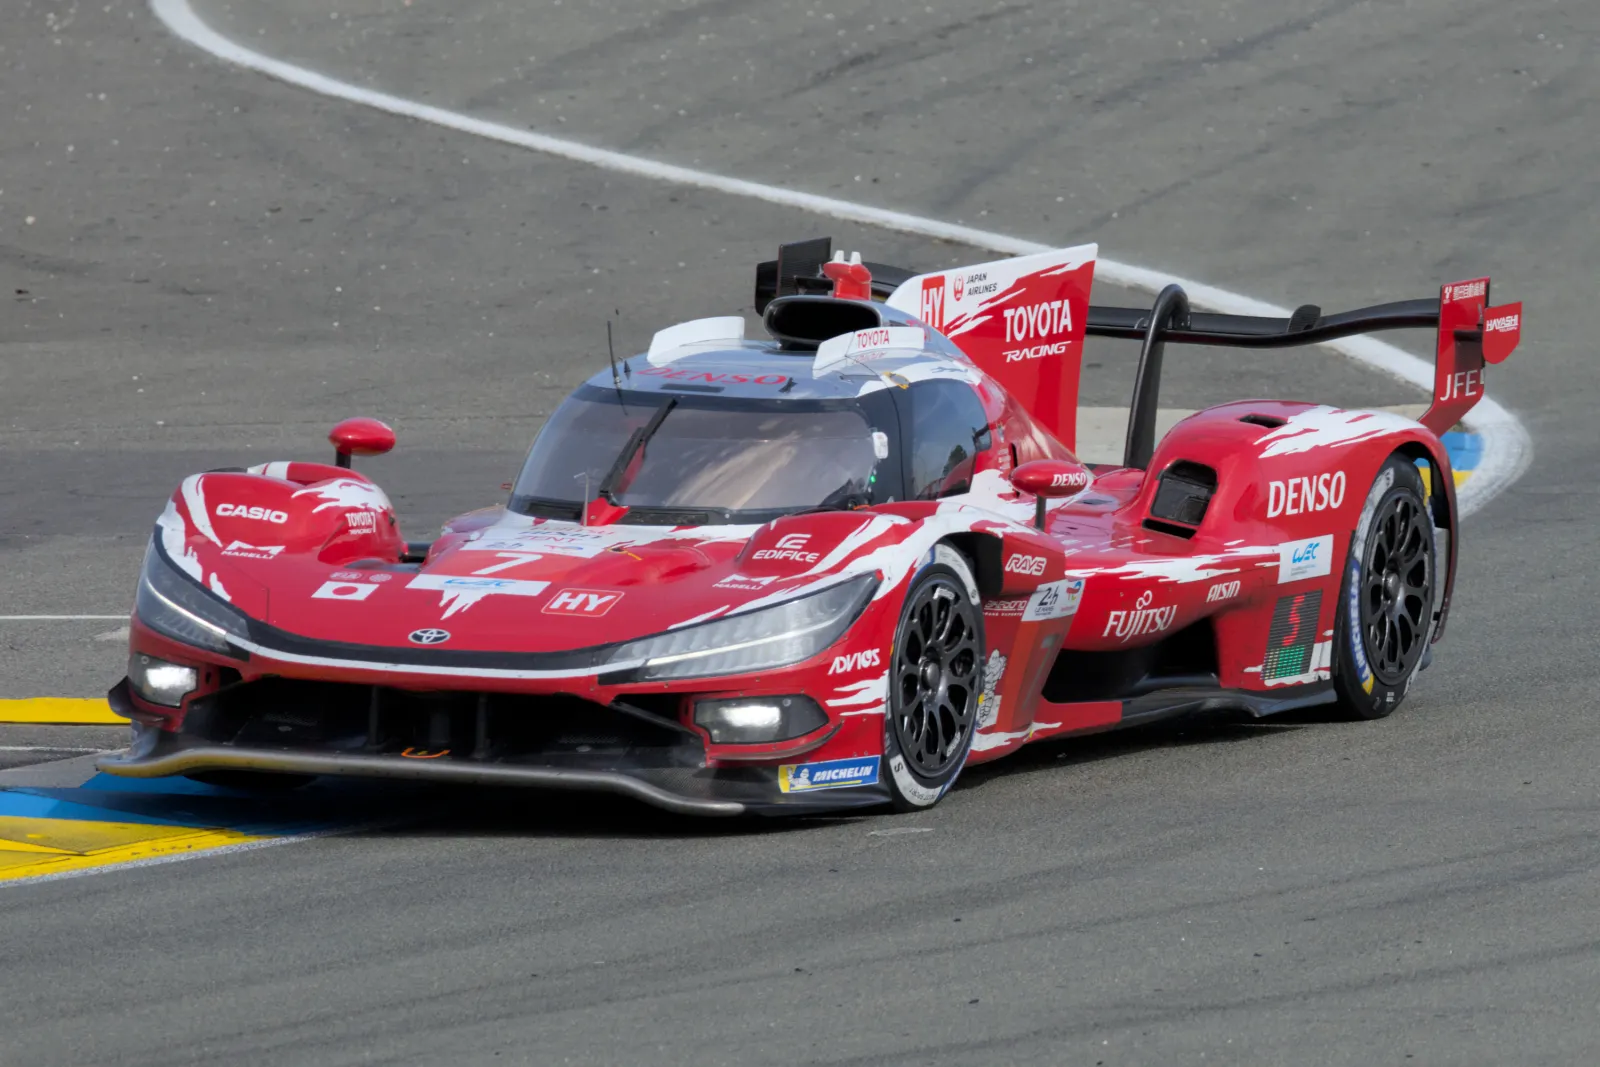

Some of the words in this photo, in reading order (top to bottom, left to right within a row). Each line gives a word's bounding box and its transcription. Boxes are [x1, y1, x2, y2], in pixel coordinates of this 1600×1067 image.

[966, 272, 988, 284] JAPAN
[967, 283, 998, 296] AIRLINES
[921, 287, 944, 328] HY
[1003, 299, 1073, 343] TOYOTA
[1486, 314, 1519, 332] HAYASHI
[856, 330, 890, 349] TOYOTA
[1002, 340, 1072, 363] RACING
[637, 367, 788, 386] DENSO
[1440, 369, 1478, 401] JFE
[1050, 472, 1087, 487] DENSO
[1266, 470, 1347, 518] DENSO
[215, 503, 289, 524] CASIO
[345, 512, 373, 527] TOYOTA
[220, 550, 275, 560] MARELLI
[470, 552, 543, 575] 7
[752, 549, 821, 563] EDIFICE
[1005, 553, 1047, 576] RAYS
[712, 583, 764, 591] MARELLI
[1206, 580, 1240, 603] AISIN
[549, 591, 616, 611] HY
[1102, 604, 1178, 643] FUJITSU
[812, 765, 873, 782] MICHELIN
